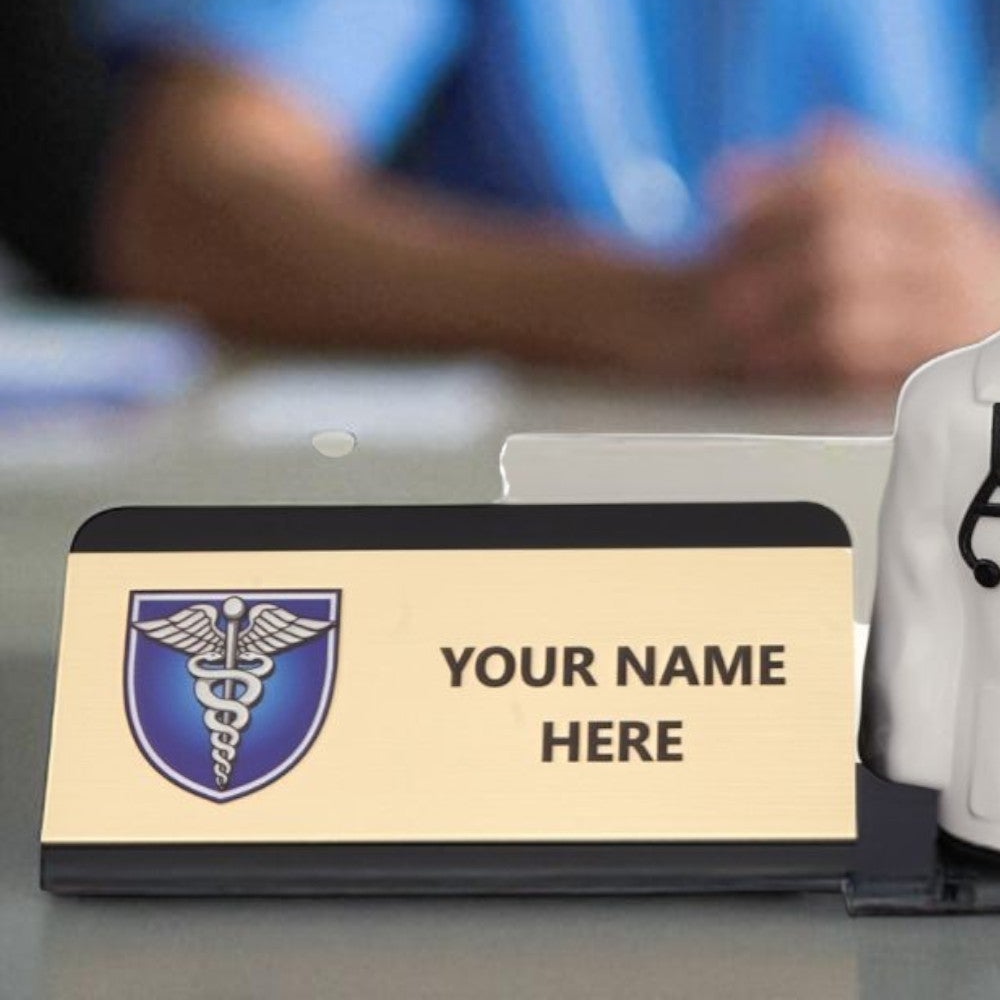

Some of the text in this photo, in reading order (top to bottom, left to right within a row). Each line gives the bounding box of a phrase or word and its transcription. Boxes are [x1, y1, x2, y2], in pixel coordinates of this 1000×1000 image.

[440, 645, 786, 688] YOUR NAME
[542, 721, 683, 763] HERE
